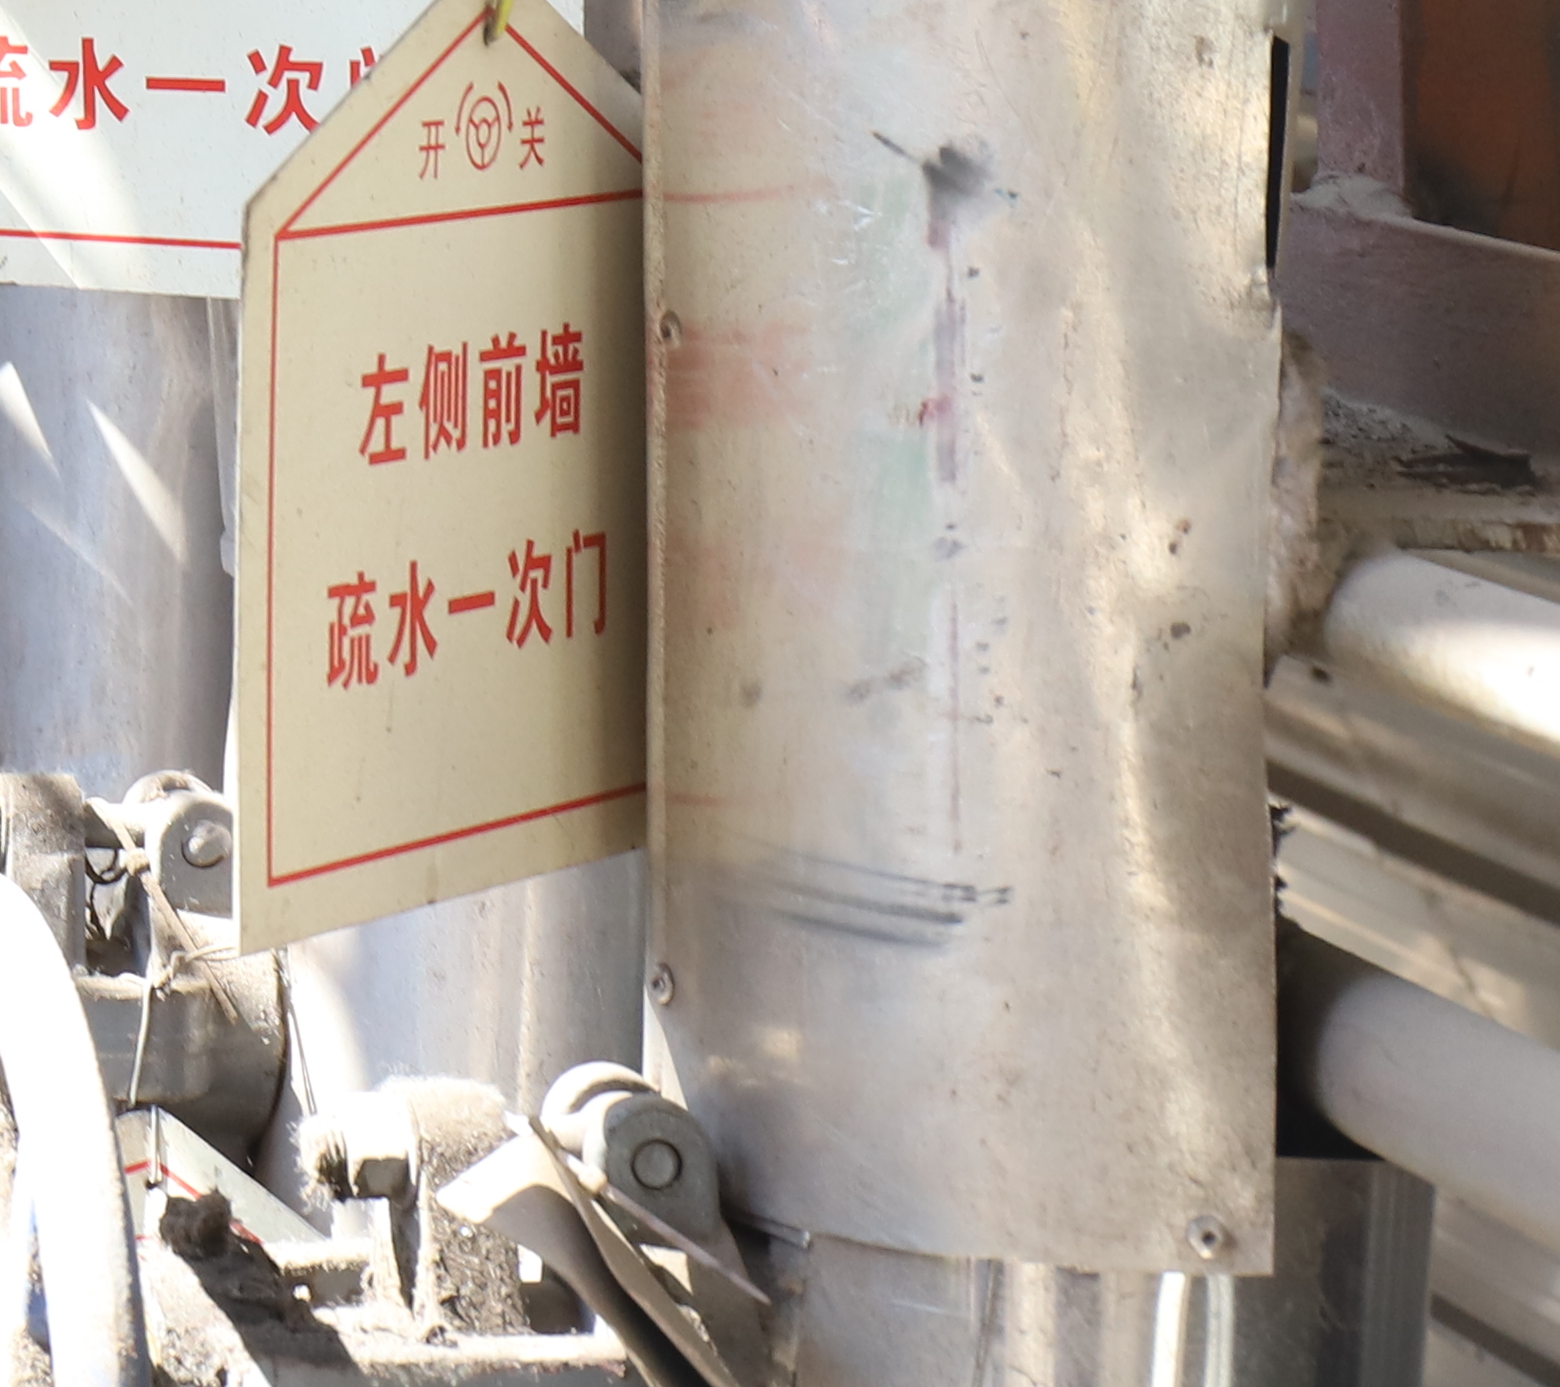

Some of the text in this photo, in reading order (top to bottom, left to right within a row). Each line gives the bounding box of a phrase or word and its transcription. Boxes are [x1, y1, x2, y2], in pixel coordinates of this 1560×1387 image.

[419, 105, 546, 180] 开 关
[358, 322, 585, 467] 左侧前墙
[325, 529, 609, 690] 疏水一次门
